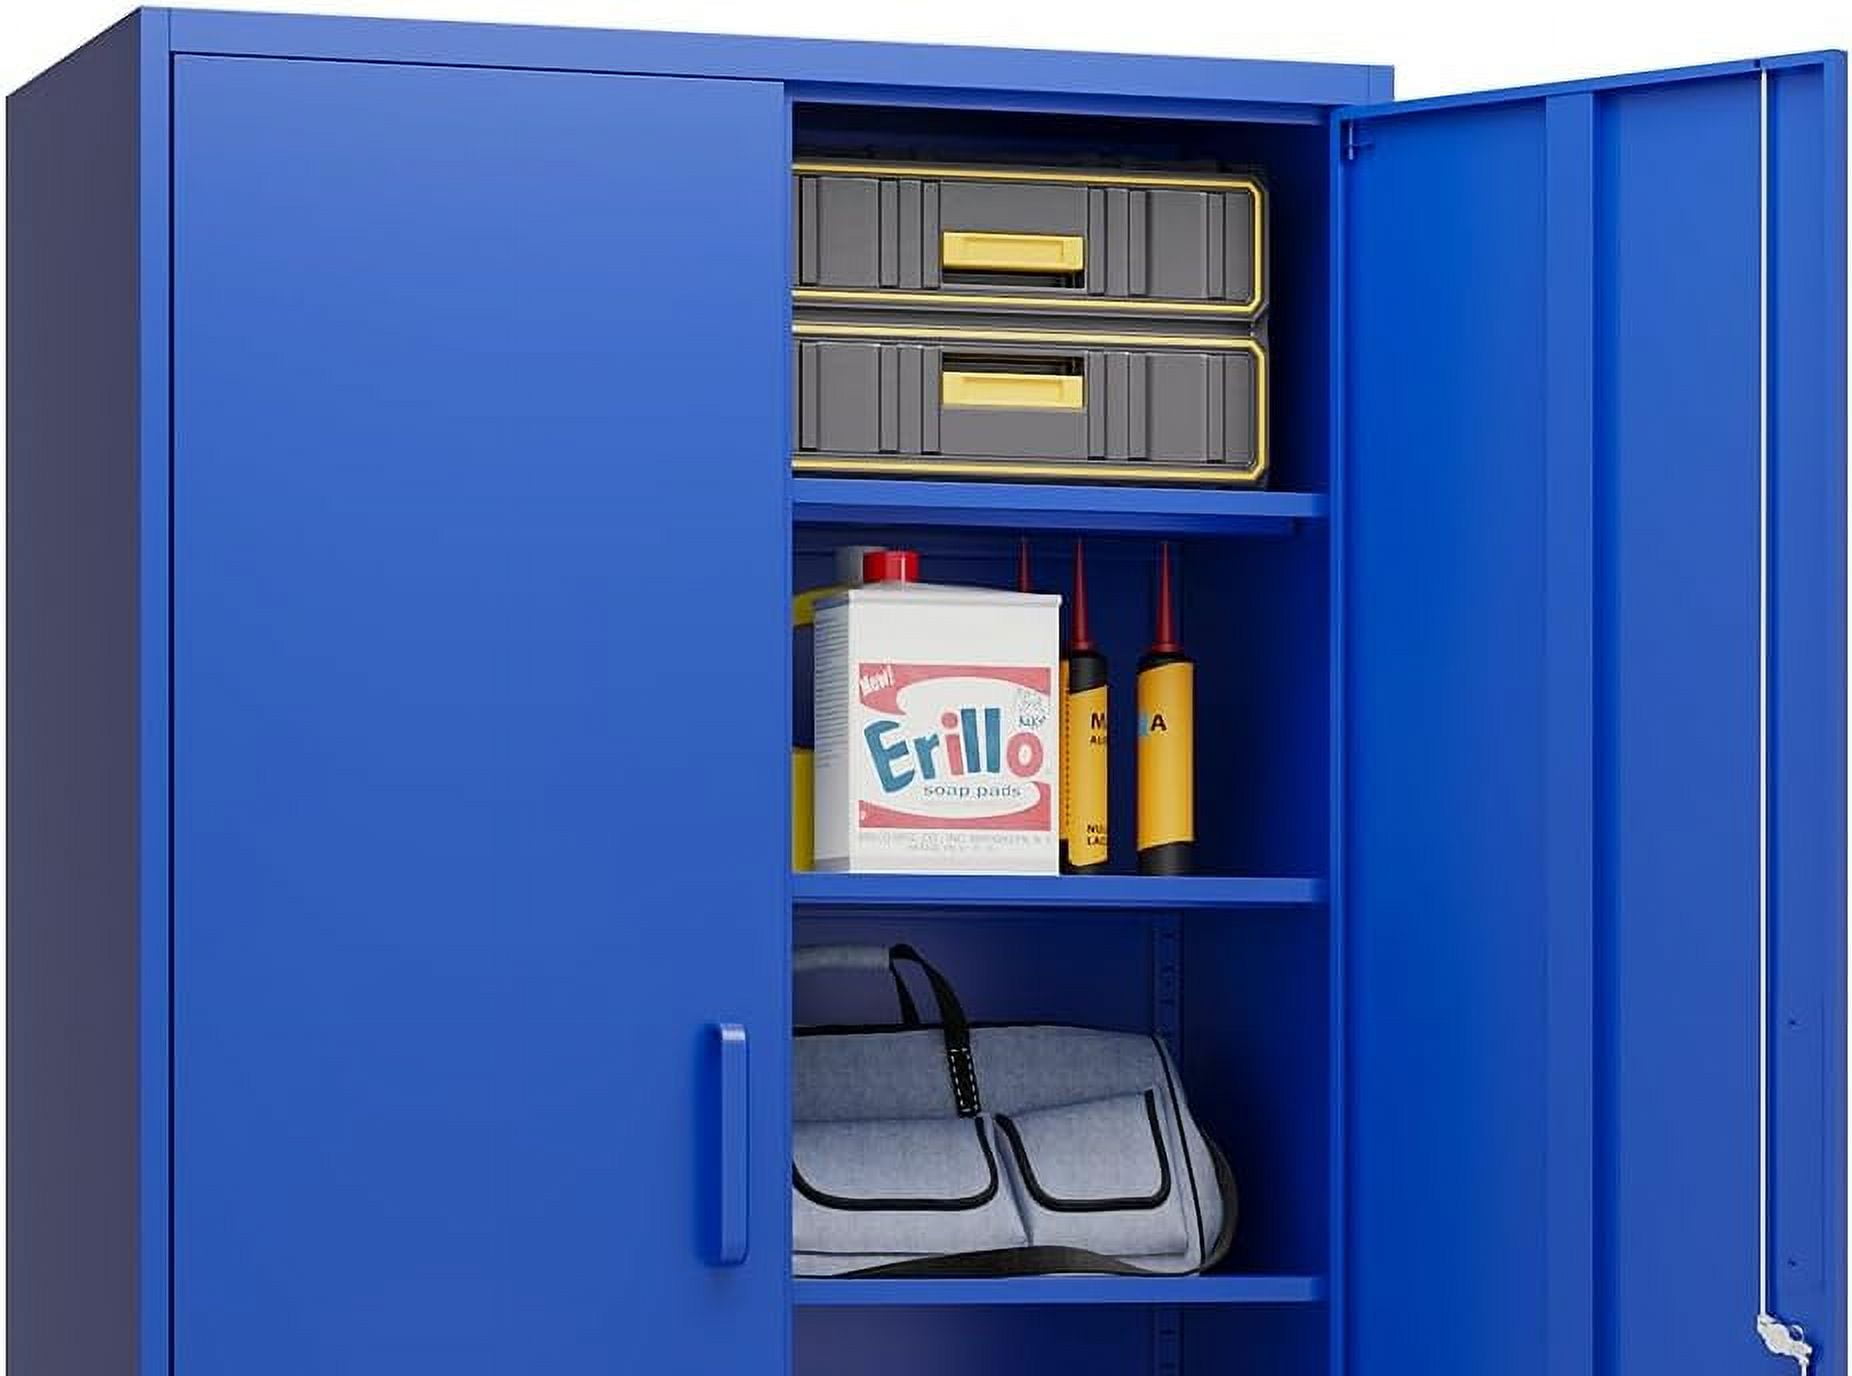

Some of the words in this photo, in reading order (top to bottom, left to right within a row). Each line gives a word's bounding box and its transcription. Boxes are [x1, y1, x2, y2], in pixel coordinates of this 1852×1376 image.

[864, 707, 1043, 793] Erillo
[924, 785, 971, 799] soap
[976, 783, 1022, 799] pads
